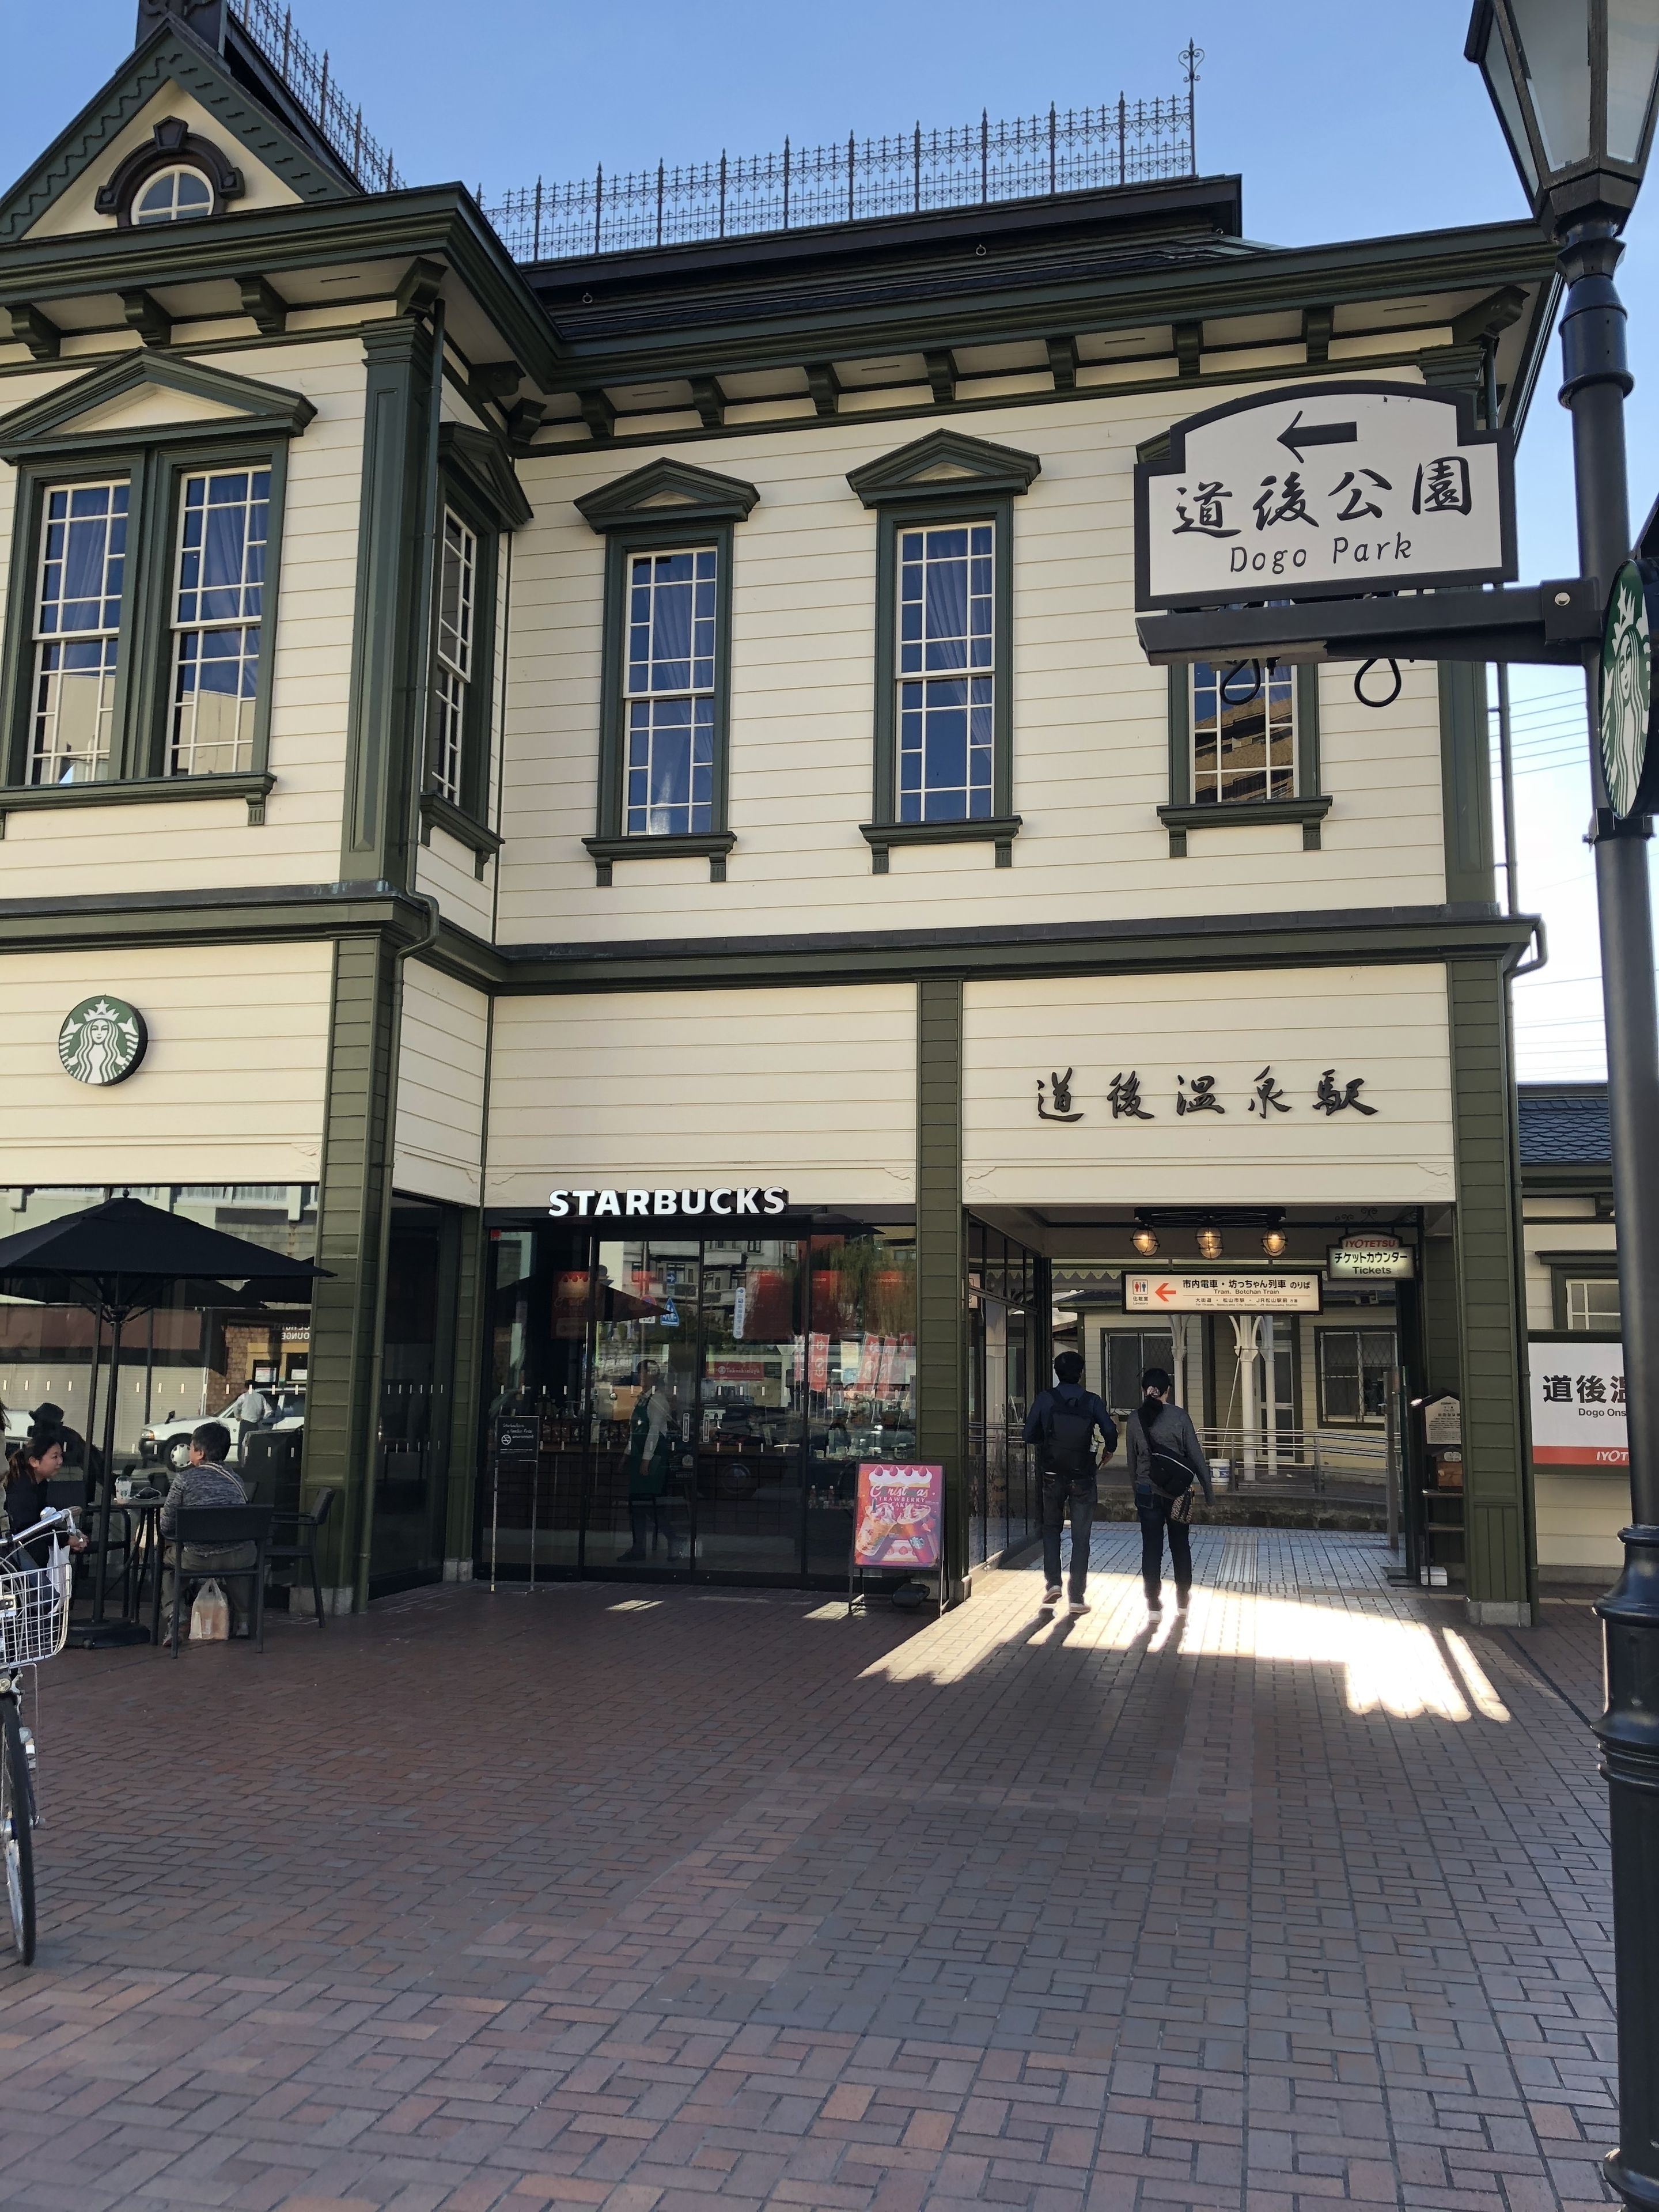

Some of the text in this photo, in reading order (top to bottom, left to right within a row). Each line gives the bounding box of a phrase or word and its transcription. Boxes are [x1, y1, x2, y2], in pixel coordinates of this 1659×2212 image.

[1172, 455, 1472, 538] 道後公園
[1229, 532, 1412, 574] Dogo Park
[1036, 1065, 1379, 1123] 道後温泉駅
[548, 1187, 787, 1217] STARBUCKS
[1345, 1239, 1395, 1248] IYOTETSU
[1334, 1252, 1408, 1263] チケットカウンター
[1352, 1266, 1392, 1274] Tickets
[1578, 1408, 1605, 1418] Dogo
[1596, 1450, 1630, 1462] IYOT
